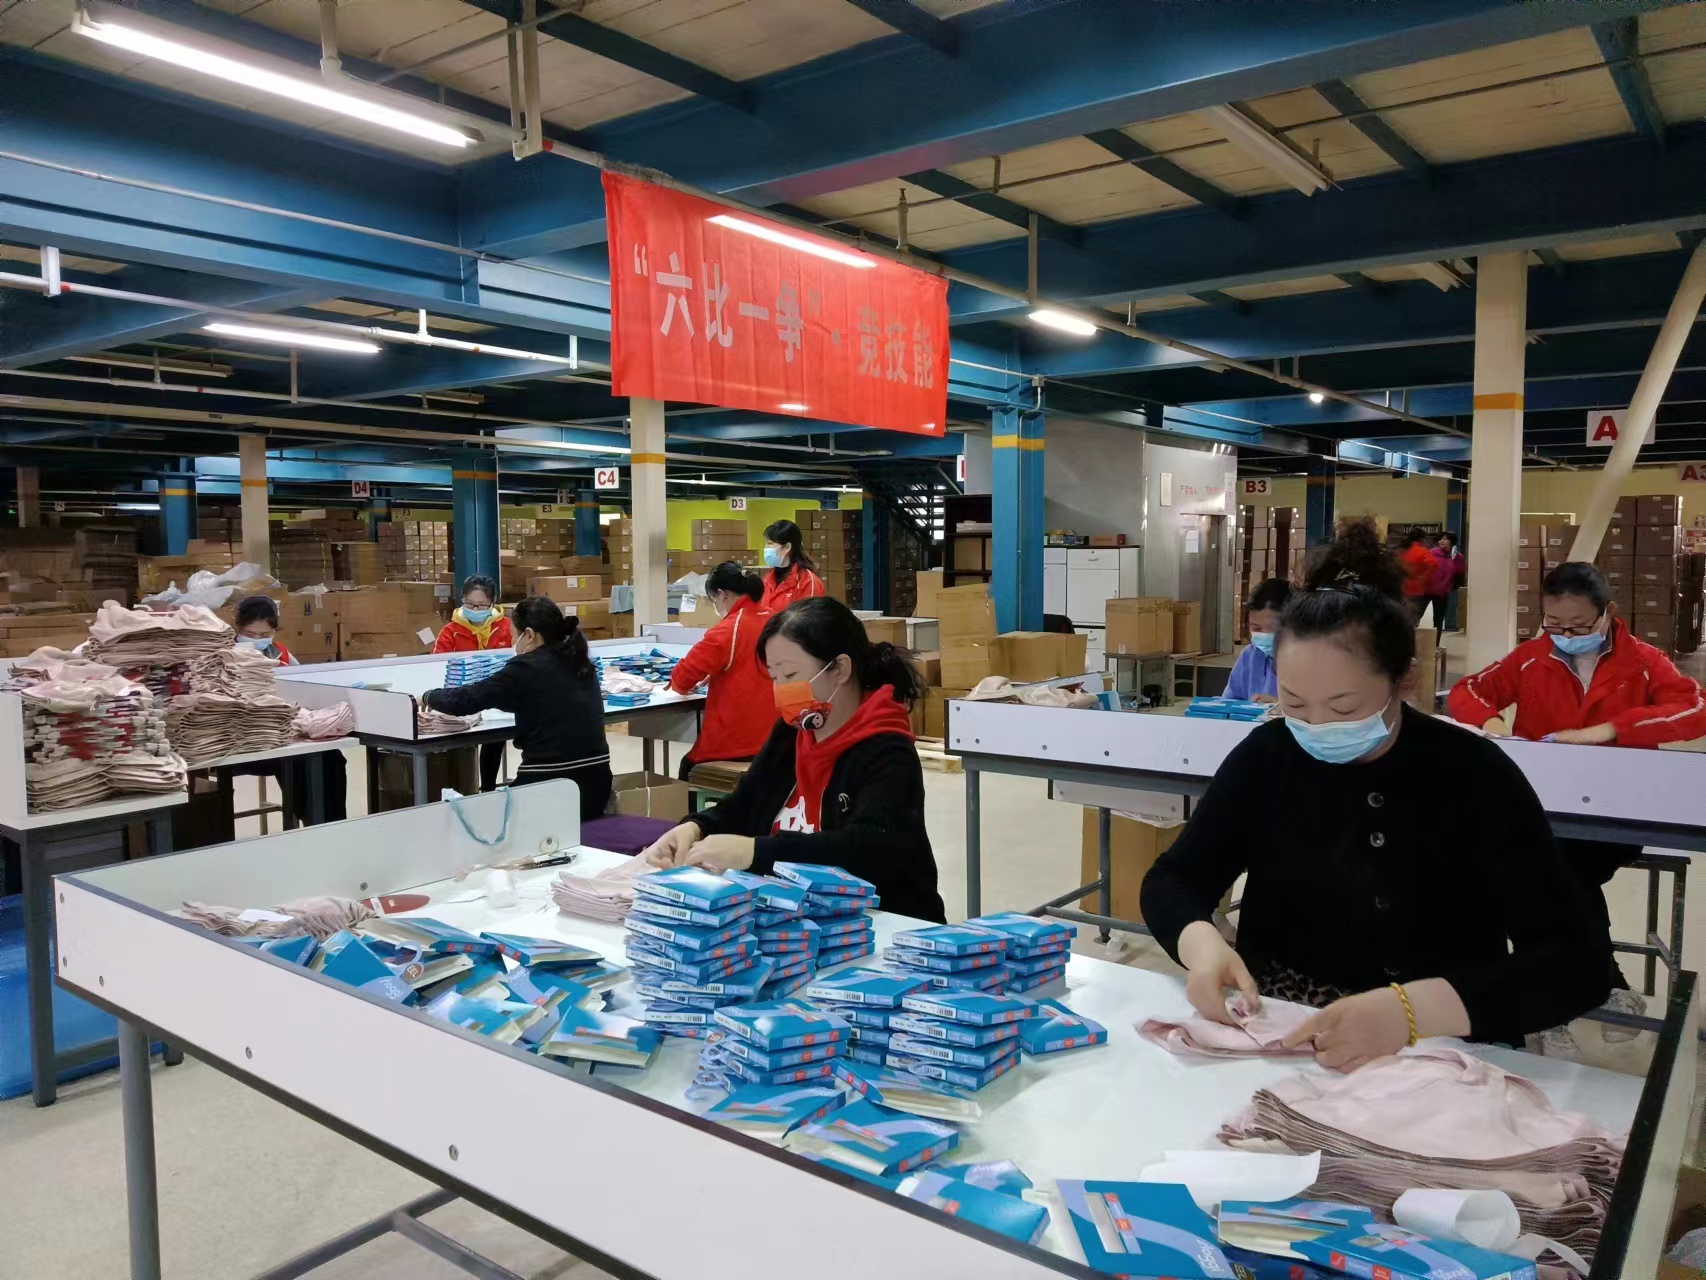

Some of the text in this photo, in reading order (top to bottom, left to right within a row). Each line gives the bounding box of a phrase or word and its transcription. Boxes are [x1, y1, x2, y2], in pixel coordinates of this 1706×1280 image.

[597, 471, 616, 485] C4
[354, 481, 367, 494] D4
[1246, 480, 1267, 493] B3
[542, 505, 553, 513] E3
[731, 499, 744, 509] D3
